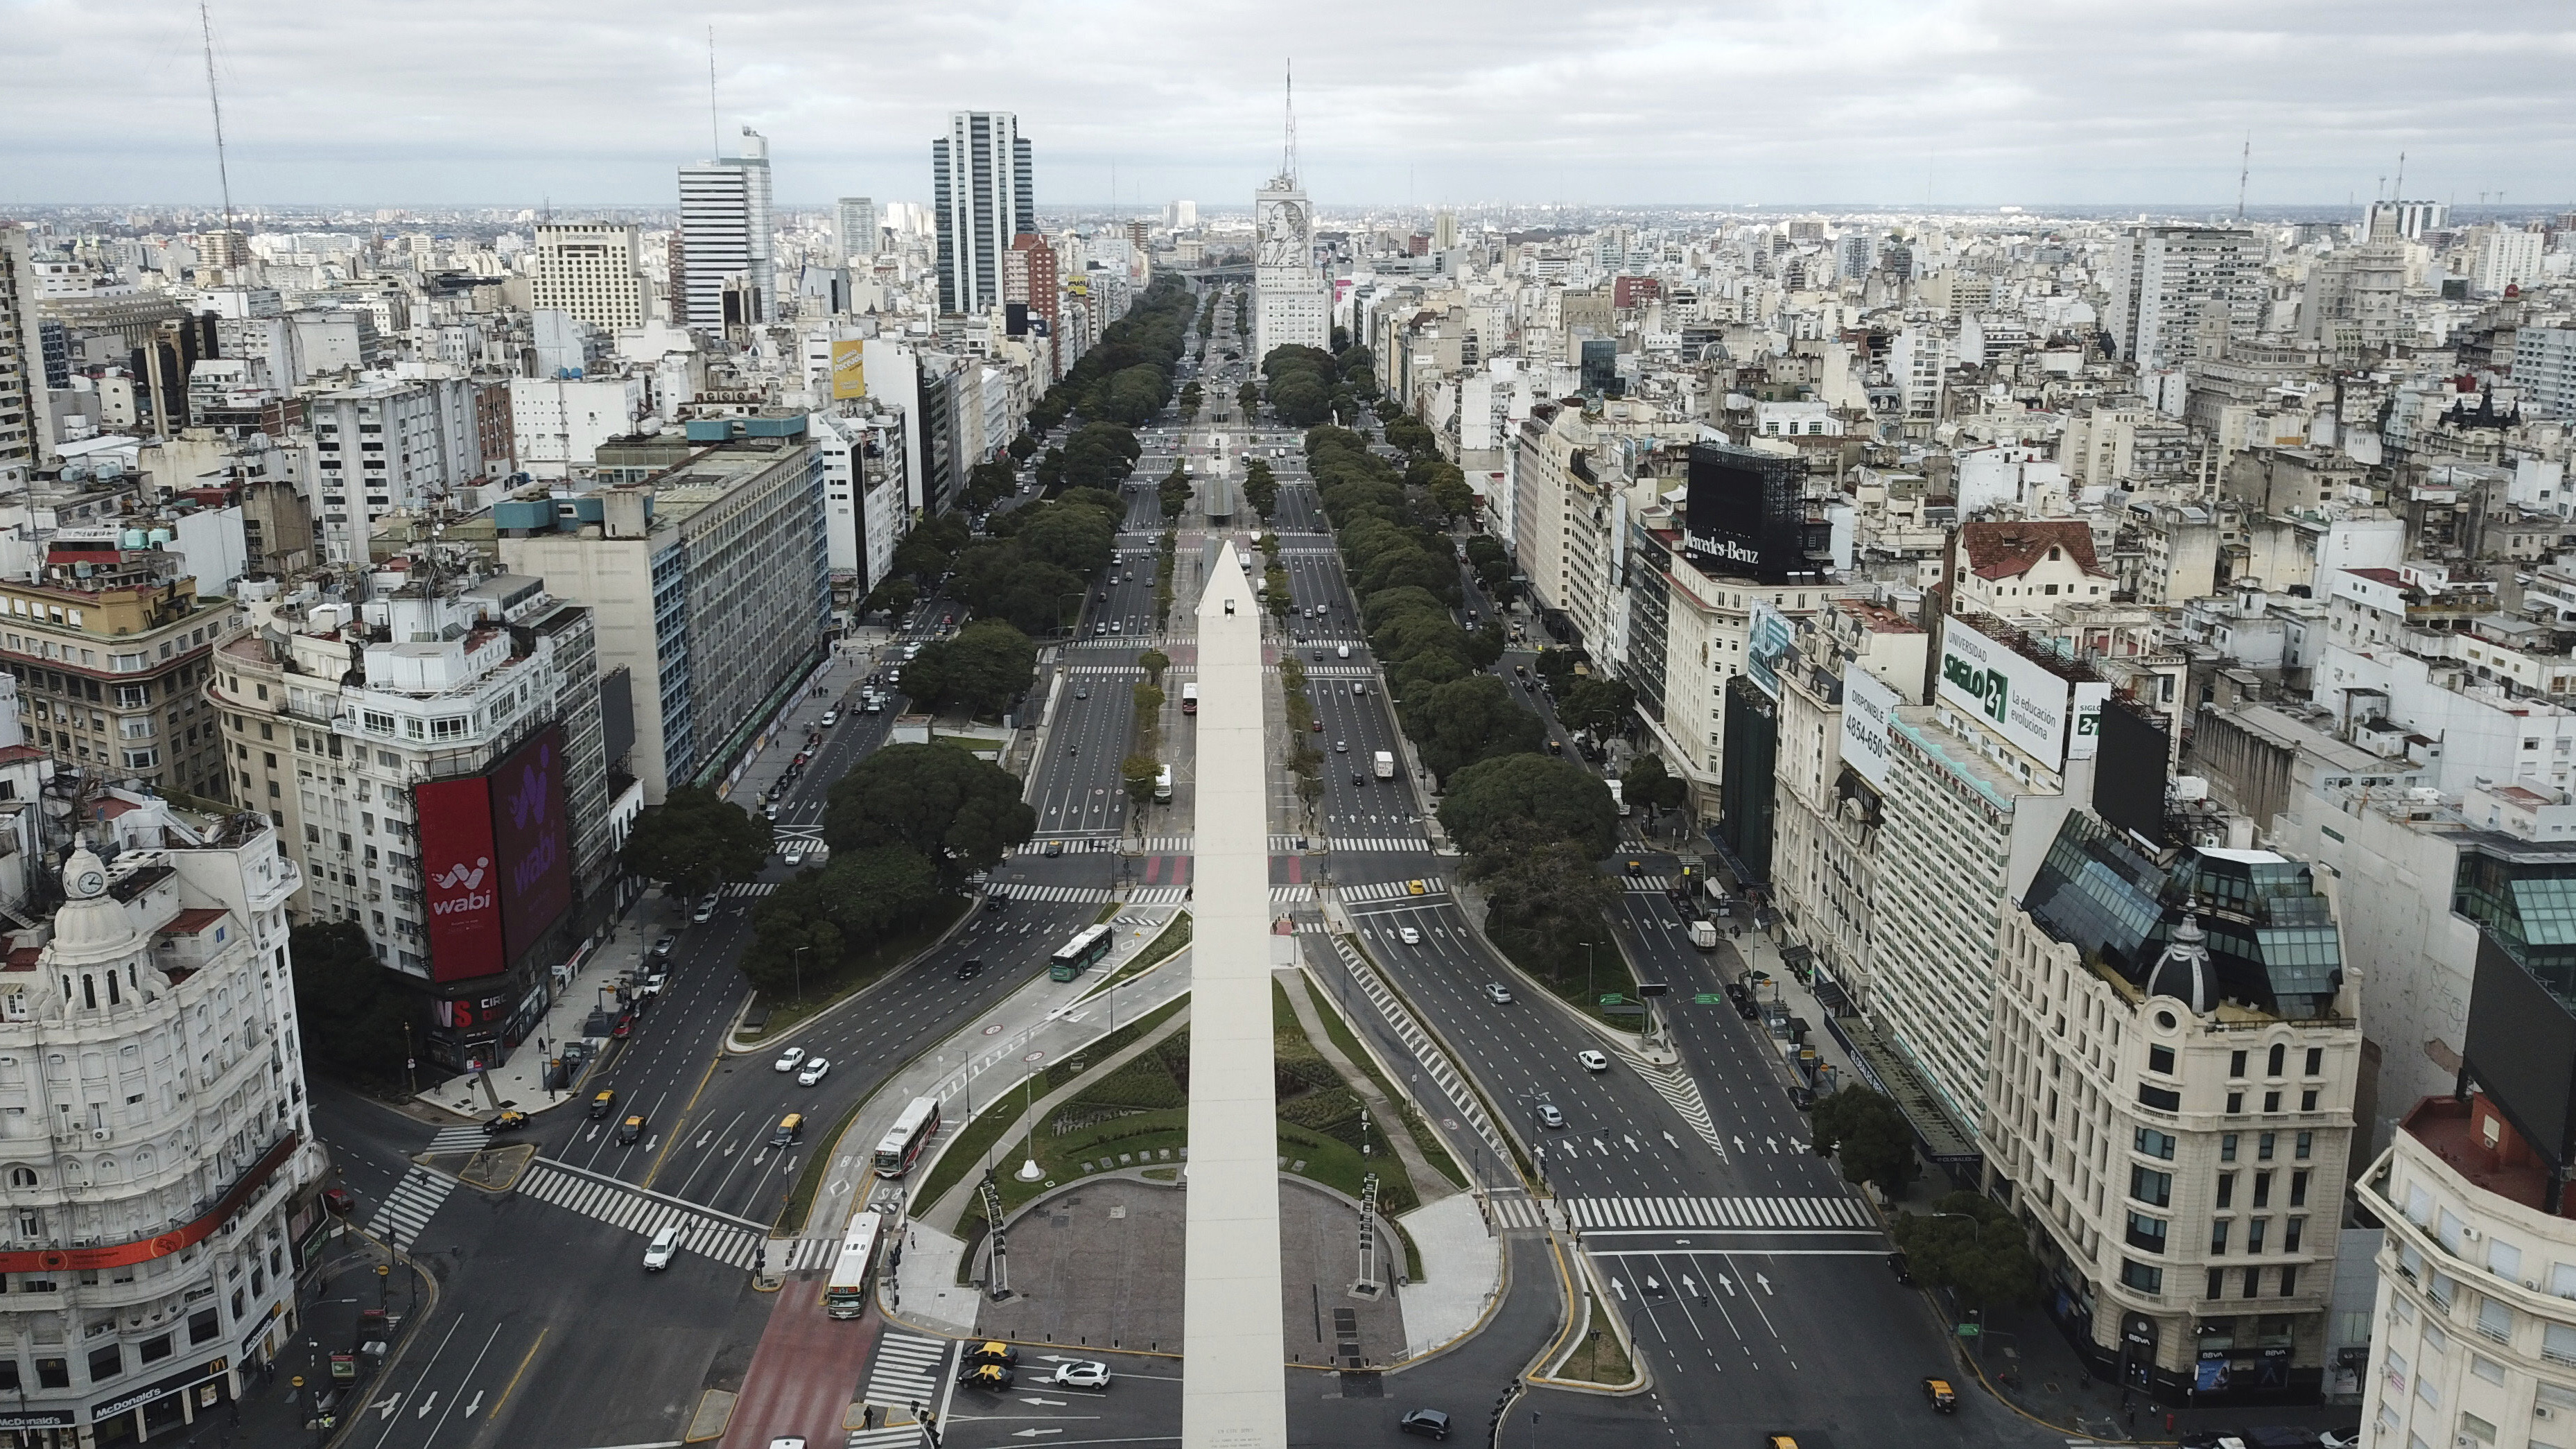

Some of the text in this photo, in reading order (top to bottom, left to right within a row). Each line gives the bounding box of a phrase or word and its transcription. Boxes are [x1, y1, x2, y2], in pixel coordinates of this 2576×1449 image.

[1683, 528, 1759, 564] Mercedes-Benz
[1949, 630, 1987, 663] UNIVERSIDAD
[1944, 653, 1985, 699] SIGLO
[1852, 689, 1883, 724] DISPONIBLE
[2012, 689, 2055, 728] La educación
[2011, 709, 2047, 740] evoluciona
[2080, 718, 2099, 736] 21
[433, 889, 491, 915] wabi
[2128, 1333, 2150, 1346] BBVA
[96, 1387, 161, 1418] McDonald's
